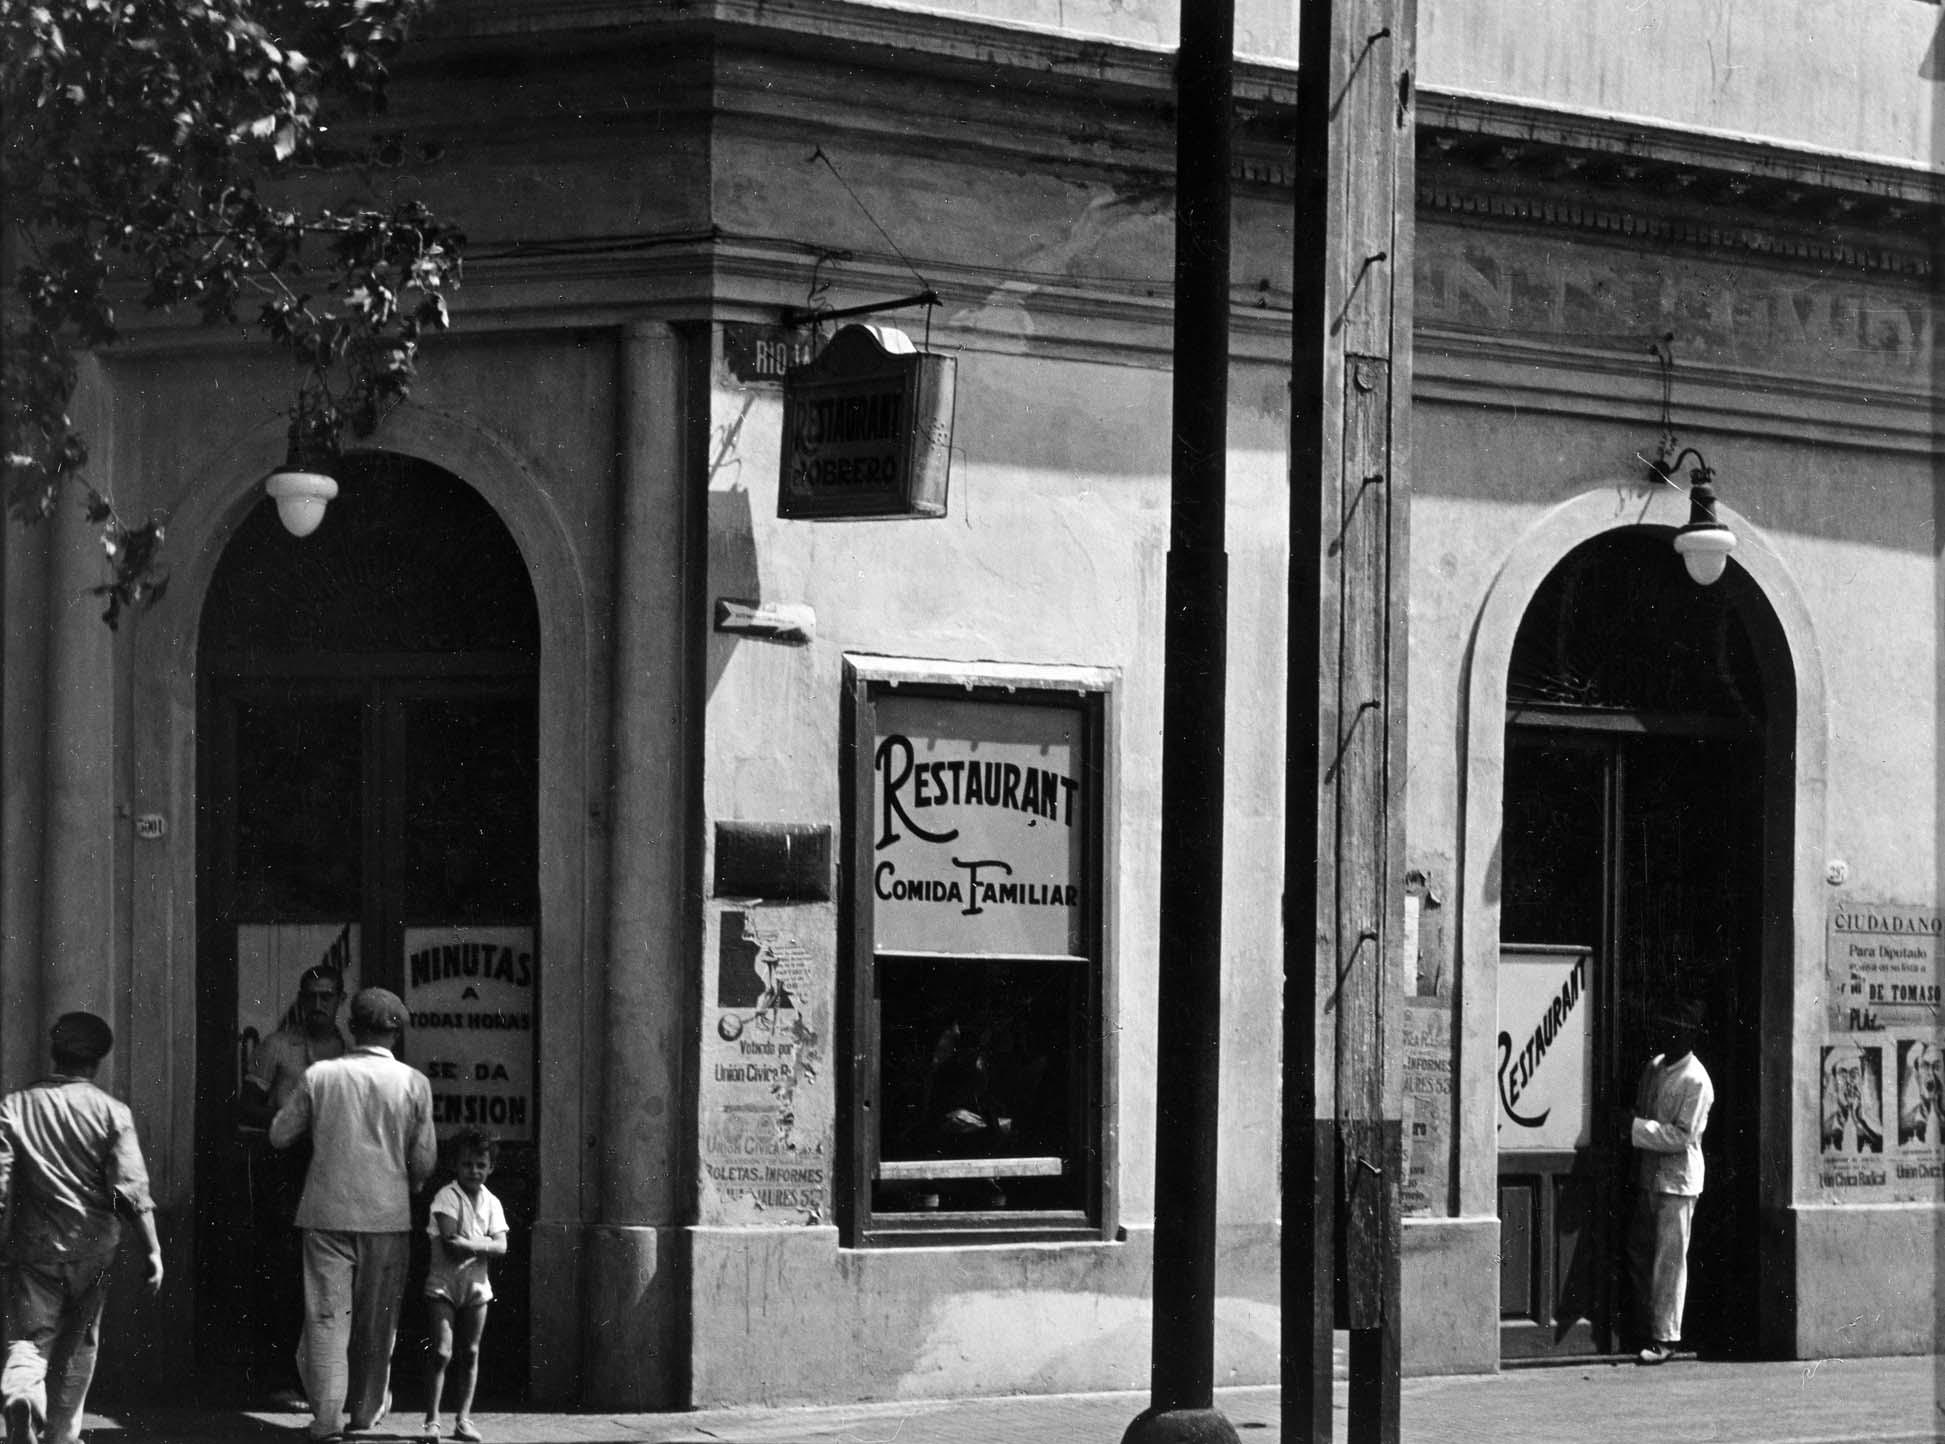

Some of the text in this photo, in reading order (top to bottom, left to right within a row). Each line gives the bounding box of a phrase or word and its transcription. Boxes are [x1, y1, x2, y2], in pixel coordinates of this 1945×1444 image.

[875, 734, 1079, 850] RESTAURANT
[875, 857, 1078, 915] COMIDA FAMILIAR
[1834, 913, 1943, 932] CIUDADANO
[1849, 944, 1876, 958] Para
[410, 943, 532, 988] MINUTAS
[462, 986, 479, 1000] A
[1869, 983, 1885, 1001] DE
[410, 1012, 531, 1030] TODAS HORAS
[428, 1061, 509, 1081] SE DA
[431, 1096, 527, 1126] ENSION
